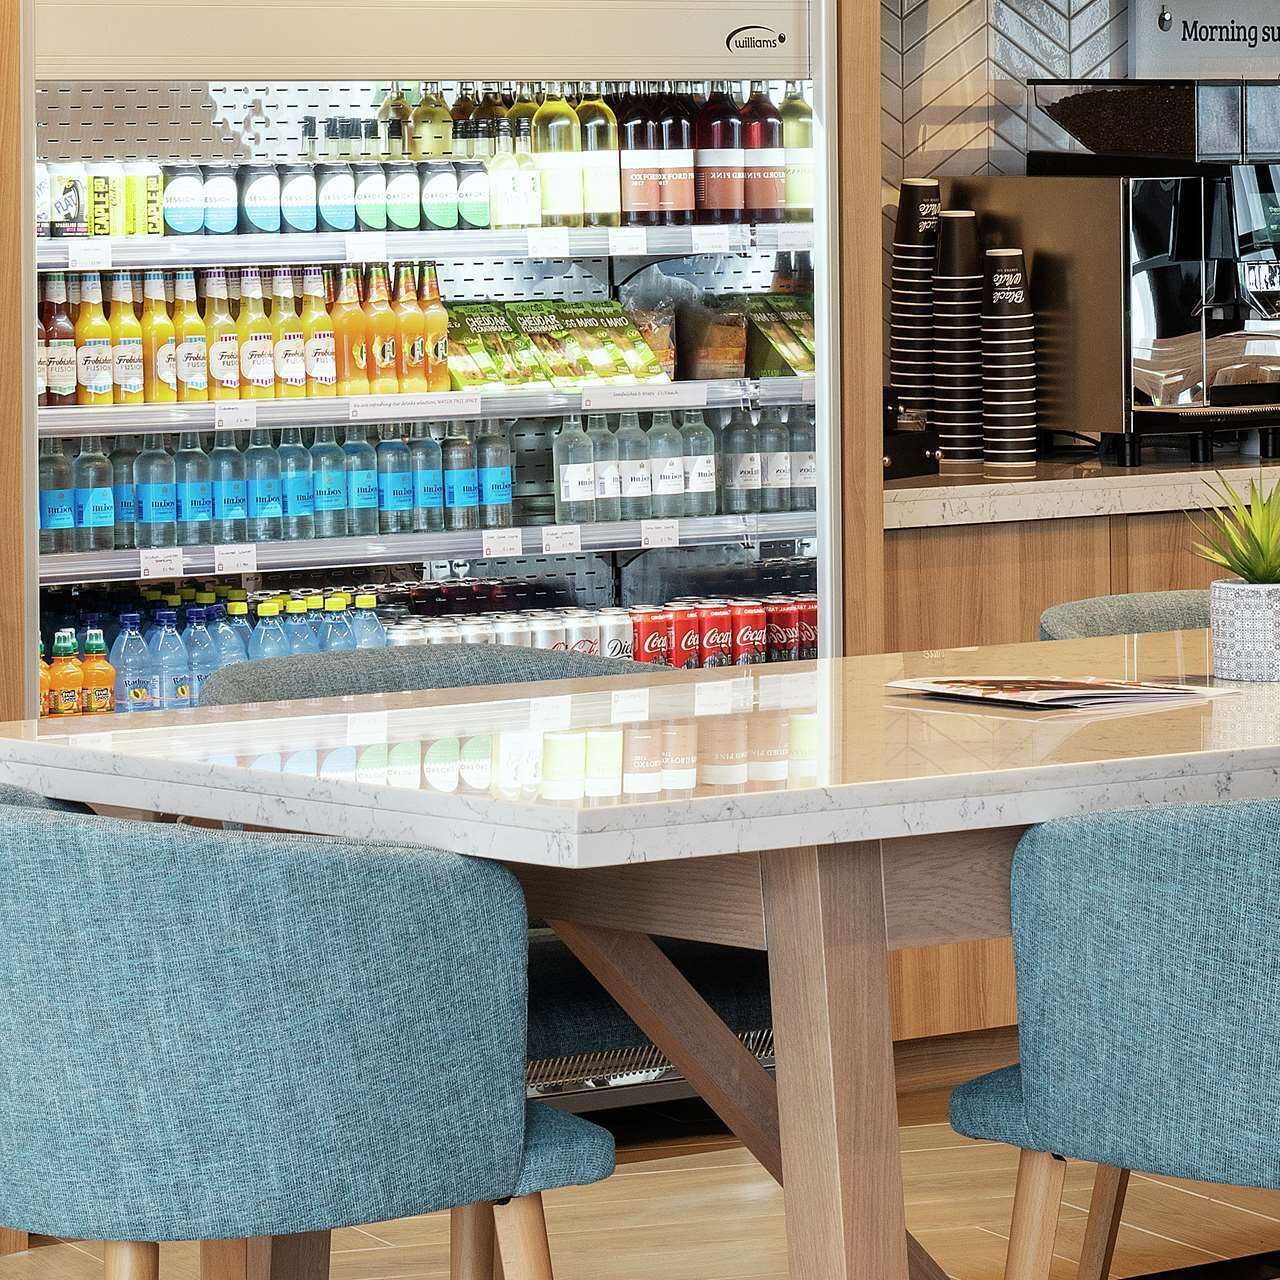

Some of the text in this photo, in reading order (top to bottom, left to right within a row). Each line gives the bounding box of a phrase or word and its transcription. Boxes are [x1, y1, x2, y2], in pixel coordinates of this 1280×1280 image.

[1181, 20, 1258, 48] Morning
[735, 37, 777, 48] williams
[993, 272, 1022, 287] White
[993, 291, 1025, 304] Black
[466, 316, 509, 327] CHEDDAR
[517, 315, 559, 326] CHEDDAR
[576, 319, 598, 328] MAYO
[606, 317, 629, 327] MAYO
[316, 488, 342, 496] HILDON
